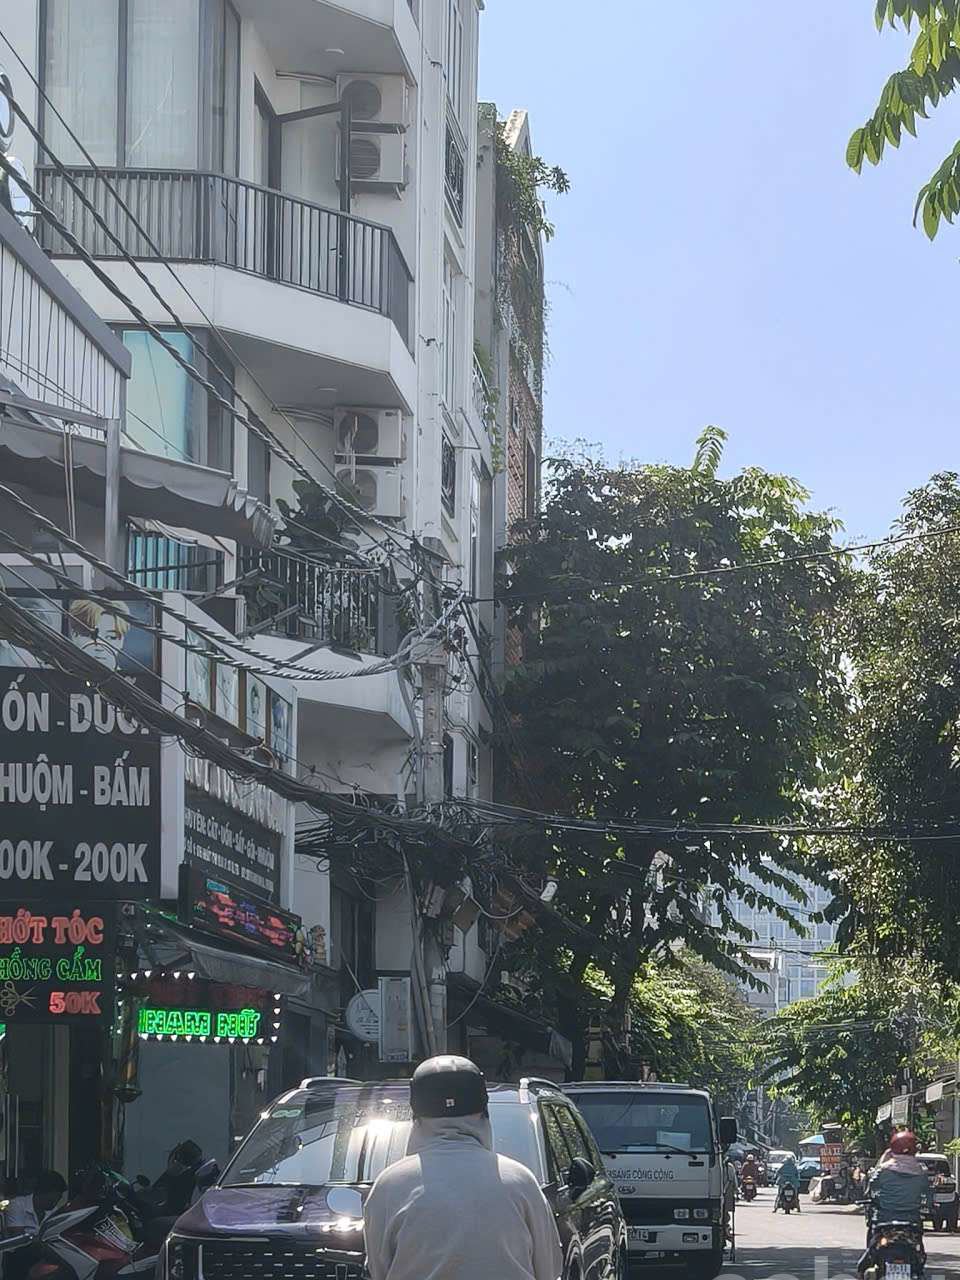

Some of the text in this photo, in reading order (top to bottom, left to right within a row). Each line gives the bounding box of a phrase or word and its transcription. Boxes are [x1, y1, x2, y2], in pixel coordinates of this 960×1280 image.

[94, 750, 150, 806] BẤM
[74, 842, 148, 882] 200K
[51, 909, 104, 944] TÓC
[48, 991, 102, 1014] 50K
[145, 1010, 211, 1036] NAM
